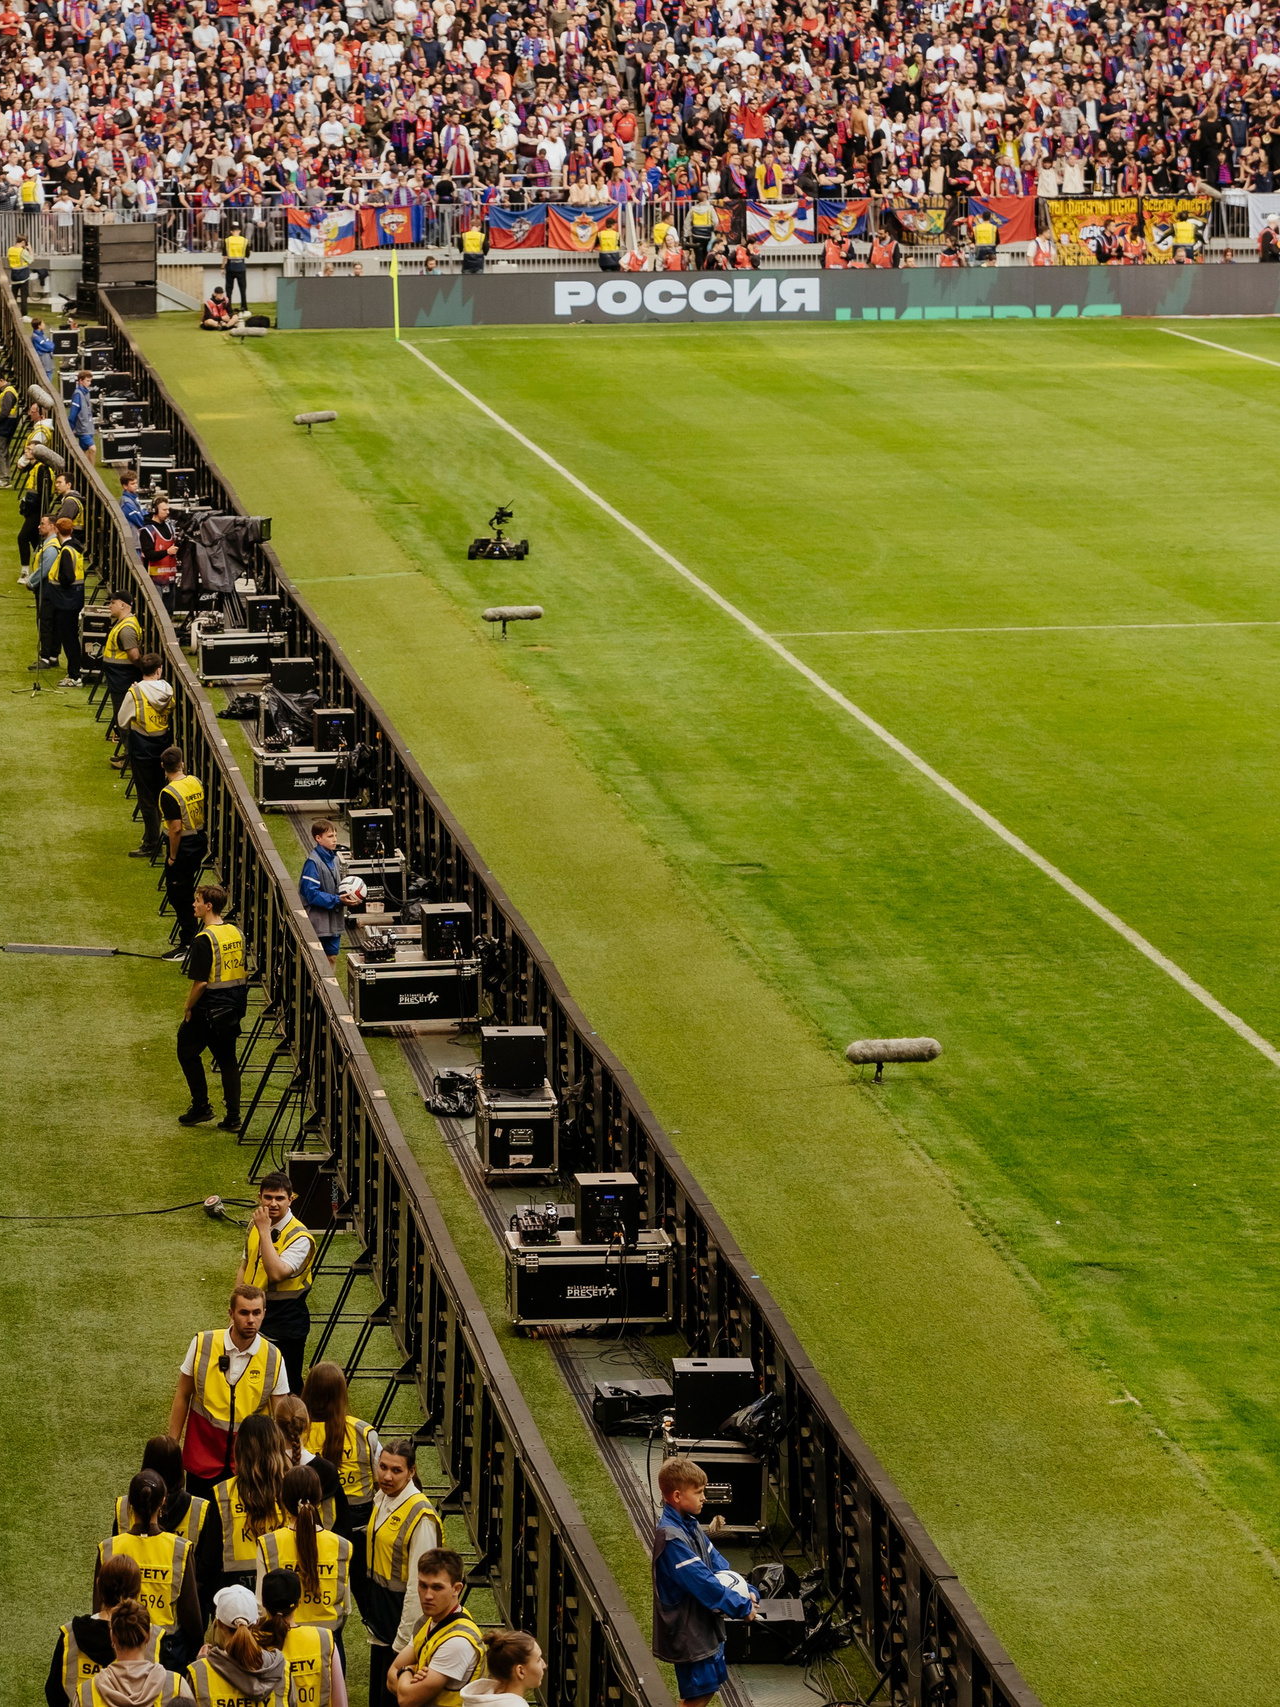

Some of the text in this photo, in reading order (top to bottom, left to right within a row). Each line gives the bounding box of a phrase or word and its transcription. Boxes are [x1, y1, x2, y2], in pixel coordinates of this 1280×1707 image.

[1111, 198, 1138, 215] ЦСКА
[1079, 226, 1105, 240] ЦСК
[554, 277, 820, 316] РОССИЯ
[222, 941, 242, 951] SAFETY
[140, 1594, 165, 1609] 596
[290, 1659, 315, 1672] ETY
